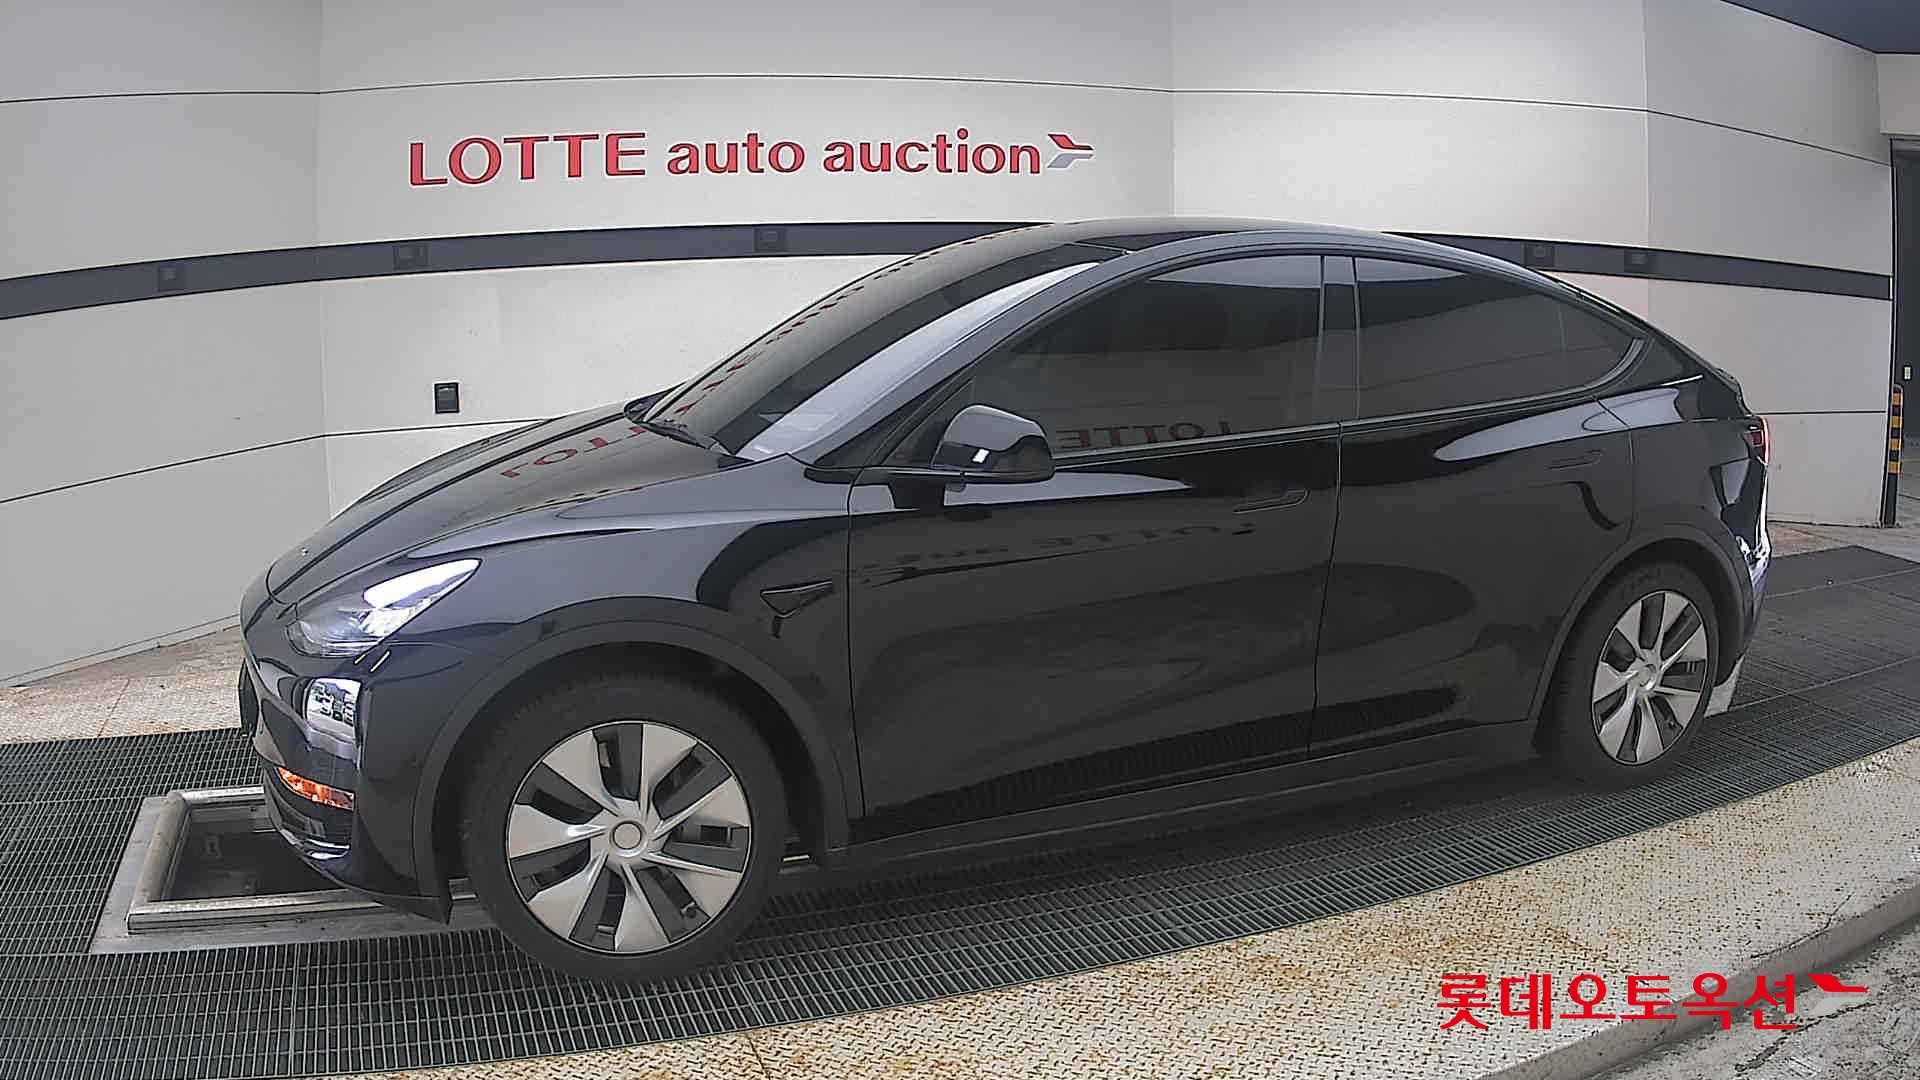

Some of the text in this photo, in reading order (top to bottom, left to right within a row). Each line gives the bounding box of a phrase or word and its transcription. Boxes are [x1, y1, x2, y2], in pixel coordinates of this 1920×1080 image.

[410, 129, 1041, 186] LOTTE auto auction
